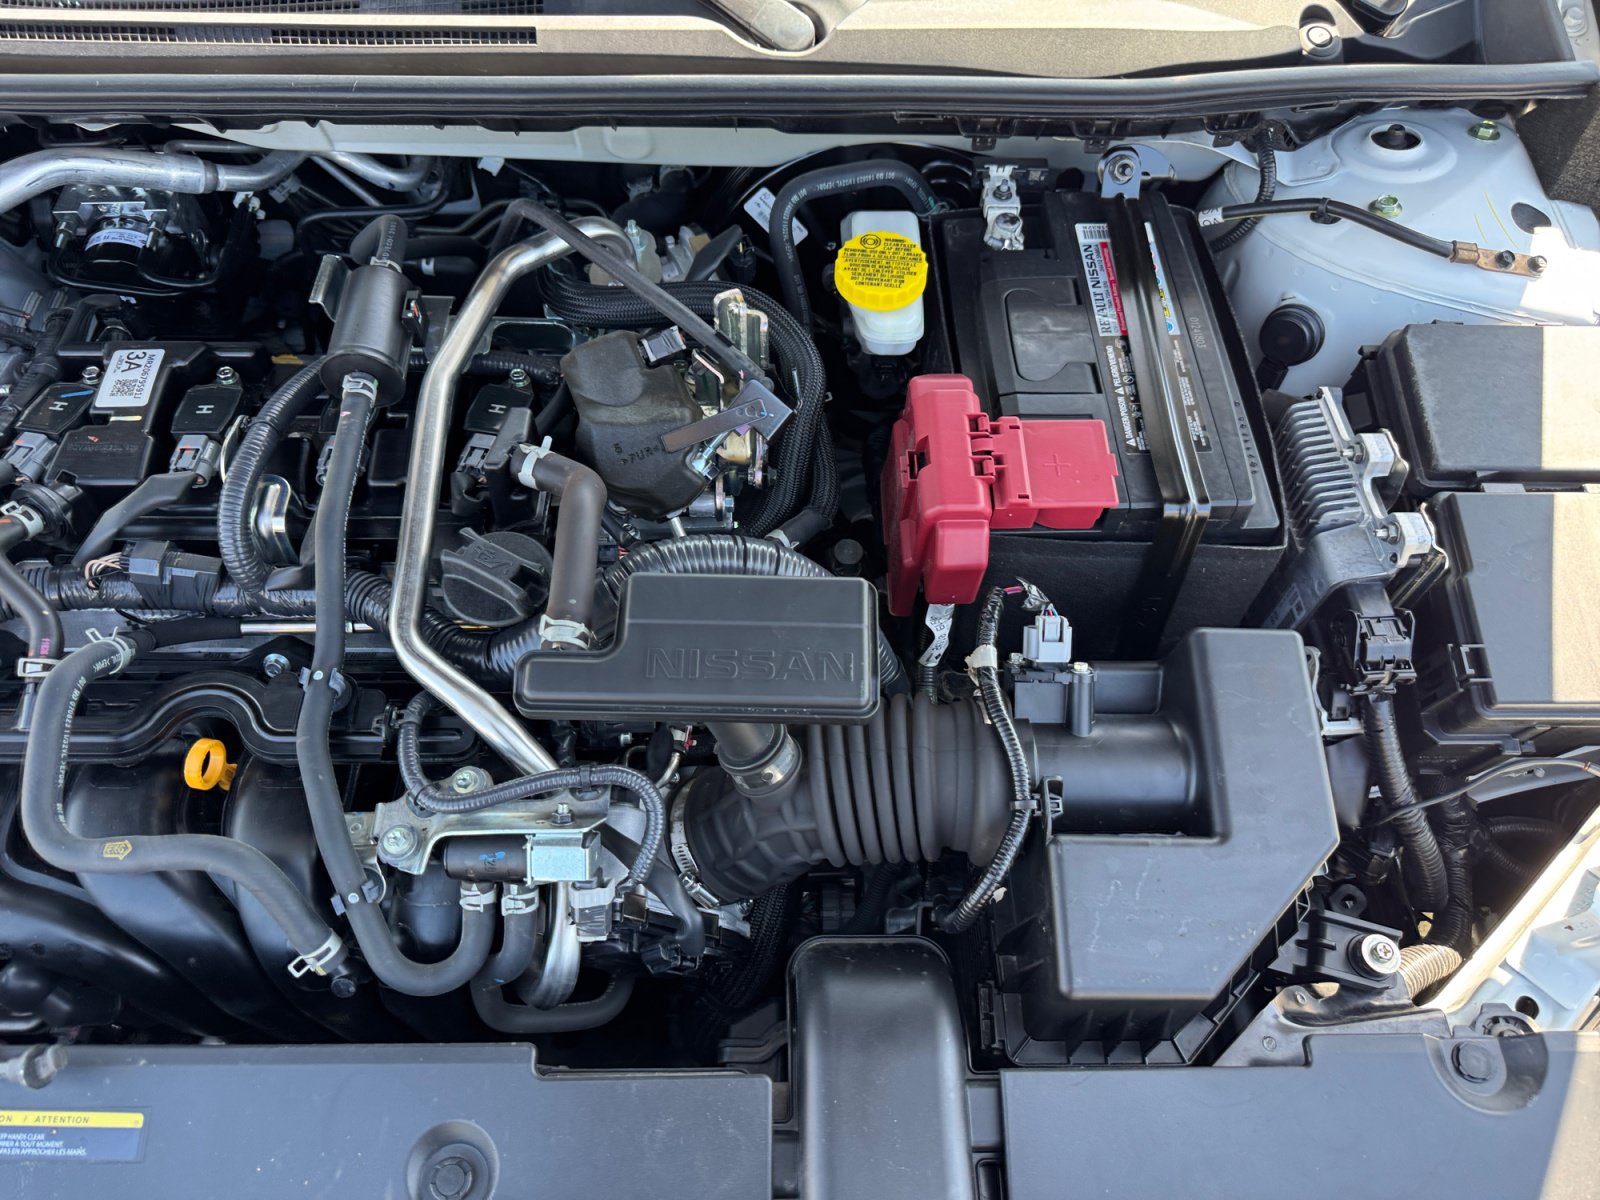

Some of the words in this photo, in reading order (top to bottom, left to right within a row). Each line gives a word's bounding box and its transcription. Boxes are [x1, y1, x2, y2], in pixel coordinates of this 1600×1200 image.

[1083, 244, 1102, 289] NISSAN
[121, 351, 147, 373] 3A
[1117, 396, 1133, 439] DANGER/POISON
[645, 647, 854, 682] NISSAN
[34, 1115, 90, 1124] ATTENTION
[20, 1140, 36, 1148] TOUT
[20, 1148, 56, 1156] APPROCHER
